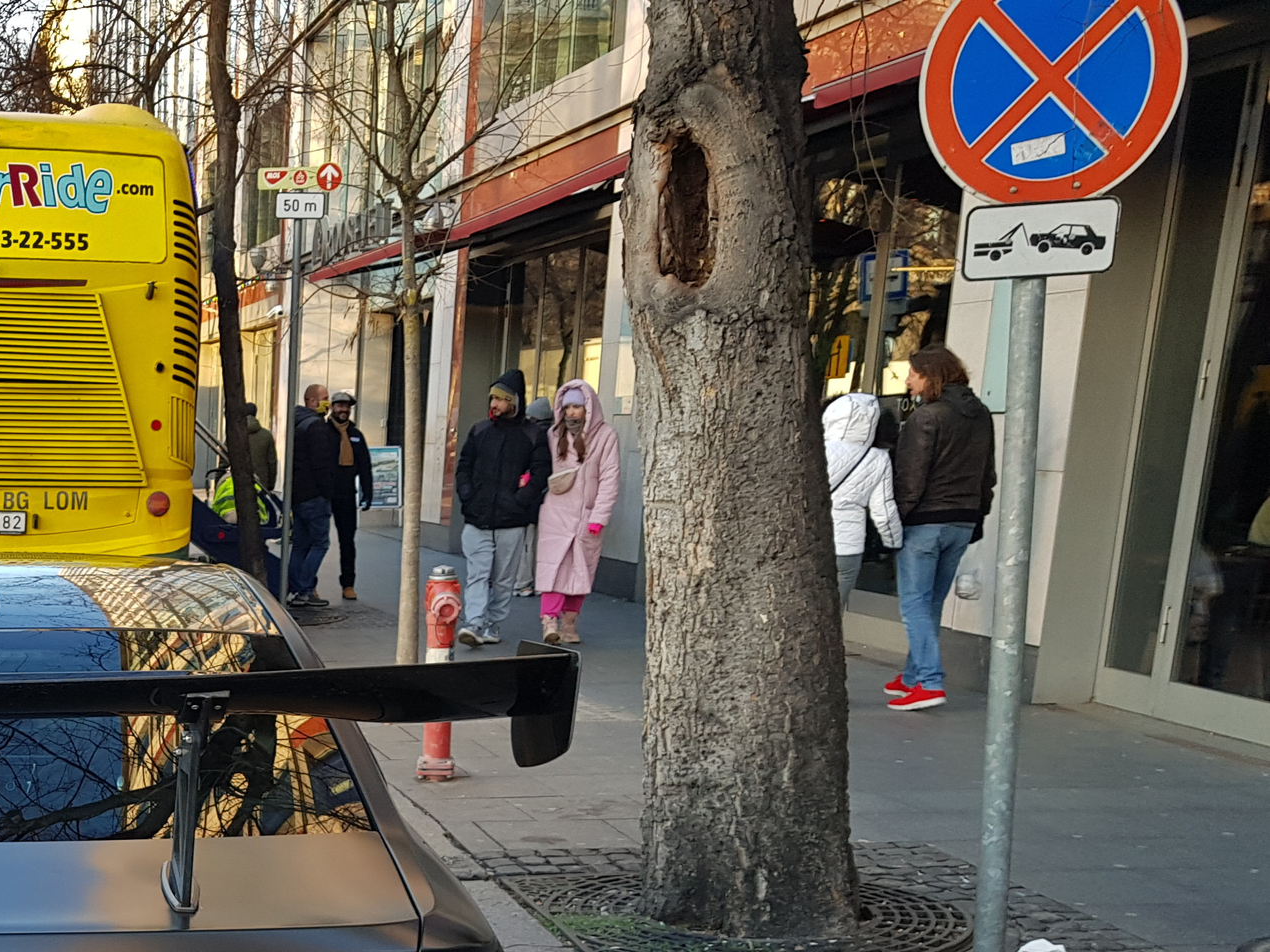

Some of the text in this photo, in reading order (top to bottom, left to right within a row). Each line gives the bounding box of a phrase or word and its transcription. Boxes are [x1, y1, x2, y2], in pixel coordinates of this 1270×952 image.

[283, 199, 317, 212] 50 m
[3, 491, 30, 510] BG
[43, 490, 89, 511] LOM
